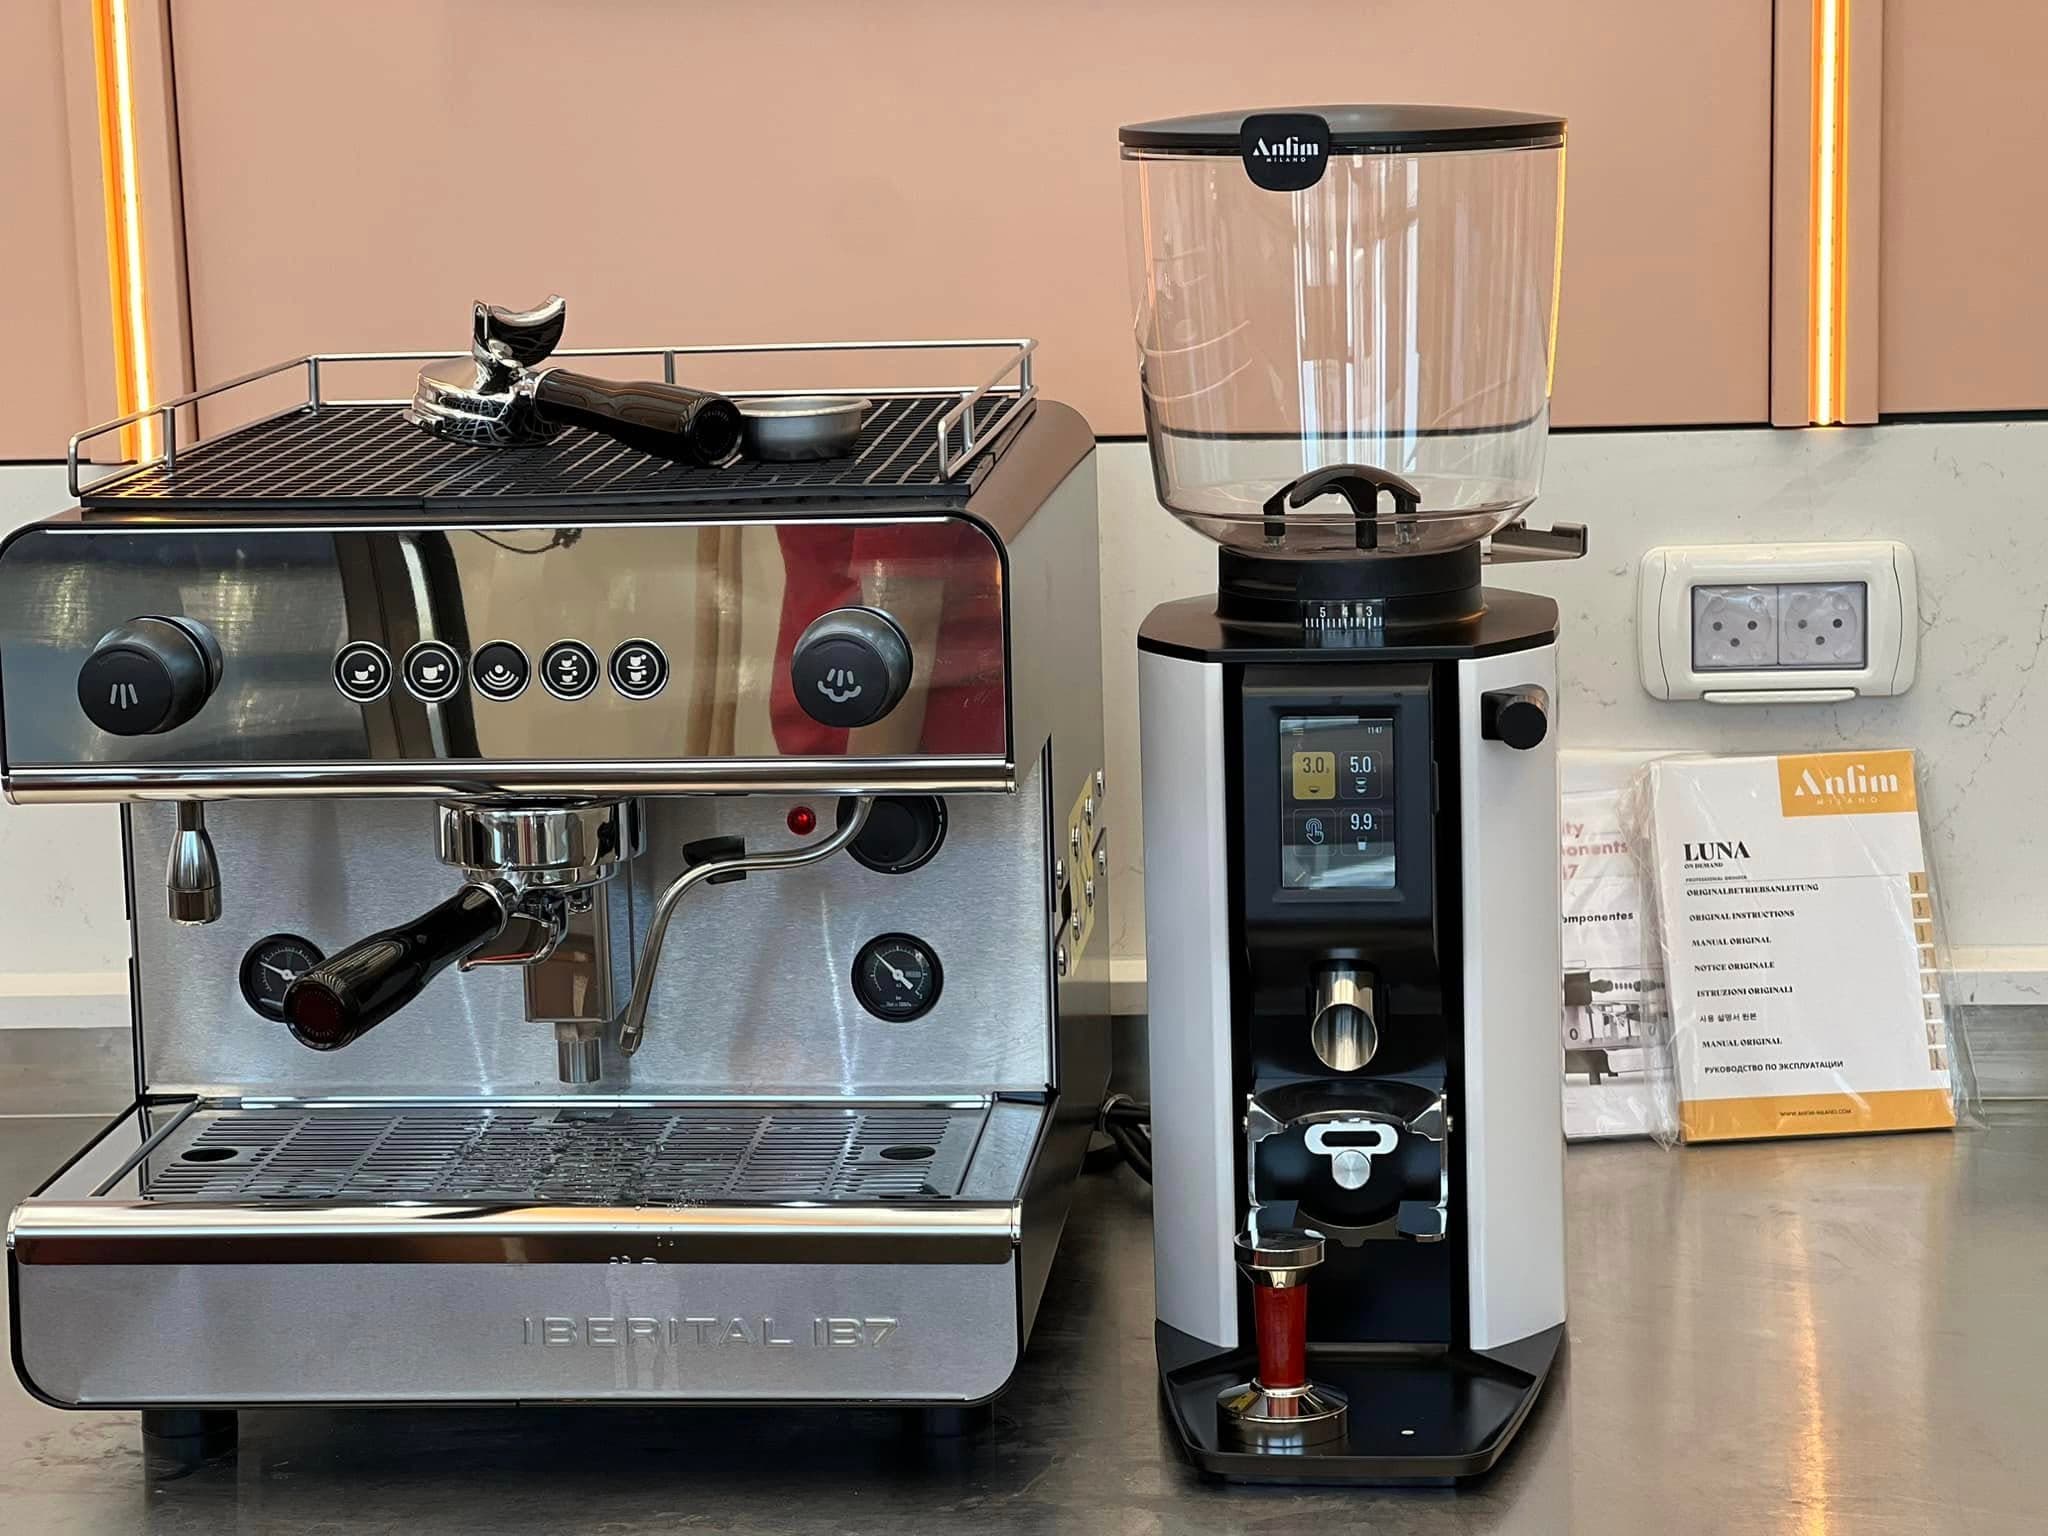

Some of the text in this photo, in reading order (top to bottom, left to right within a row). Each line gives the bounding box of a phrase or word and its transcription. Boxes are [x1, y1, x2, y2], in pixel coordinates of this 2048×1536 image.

[1252, 135, 1319, 156] Anfim
[1319, 606, 1327, 618] 5
[1365, 605, 1373, 617] 3
[1302, 756, 1325, 774] 3.0
[1350, 756, 1372, 773] 5.0
[1794, 764, 1899, 796] Anfim
[1816, 795, 1878, 806] MILANO
[1350, 812, 1373, 830] 9.9
[1683, 840, 1751, 862] LUNA
[1686, 882, 1820, 897] ORIGINALBETRIEBSANLEITUNG
[1689, 909, 1795, 922] ORIGINAL INSTRUCTIONS
[1692, 936, 1772, 947] MANUAL ORIGINAL
[1694, 961, 1776, 972] NOTICE ORIGINALE
[1697, 985, 1794, 997] ISTRUZIONI ORIGINALI
[1702, 1037, 1783, 1048] MANUAL ORIGINAL
[1704, 1060, 1844, 1074] РУКОВОДСТВО ПО ЭКСПЛУАТАЦИИ
[522, 1315, 899, 1348] IBERITAL IB7
